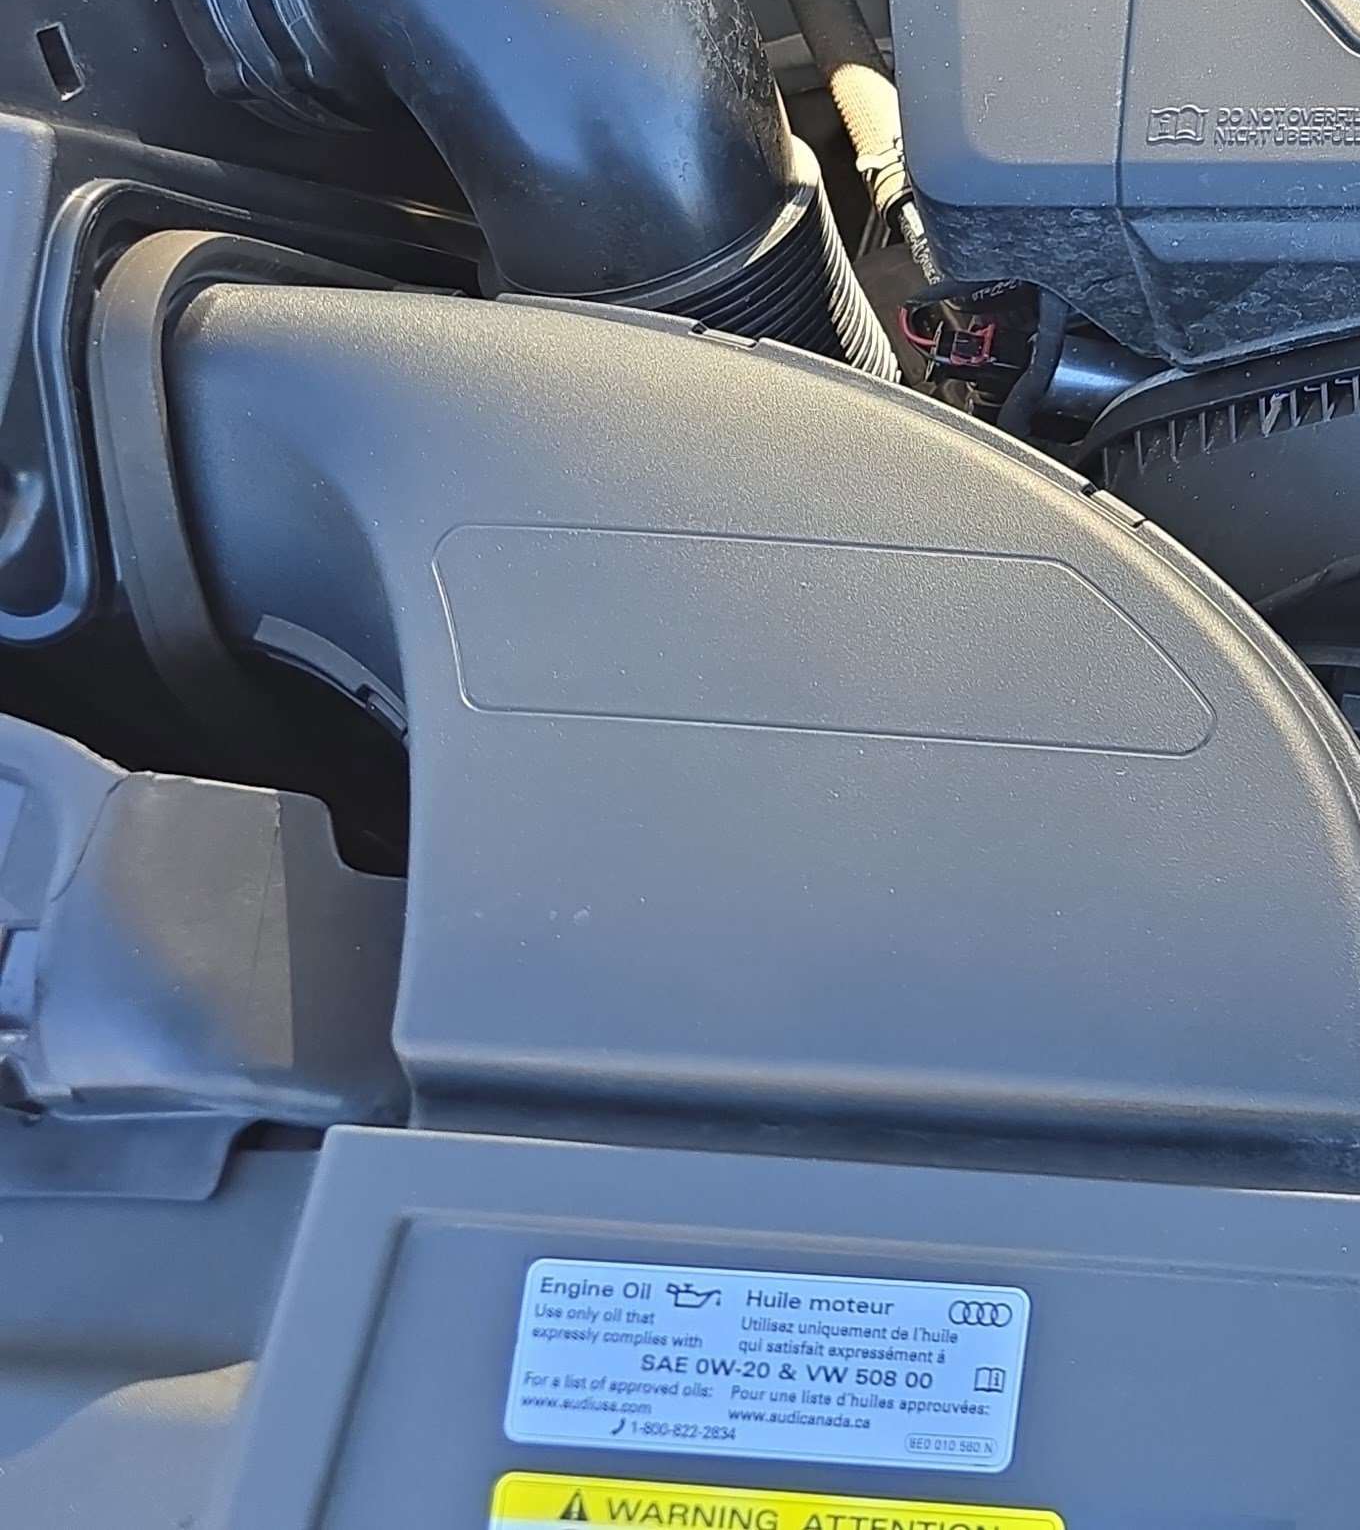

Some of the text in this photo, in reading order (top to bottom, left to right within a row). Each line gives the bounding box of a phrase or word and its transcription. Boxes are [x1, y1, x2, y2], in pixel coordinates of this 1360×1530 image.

[1216, 106, 1245, 126] DO
[1248, 106, 1287, 127] NOT
[1213, 125, 1272, 147] NICHT
[540, 1276, 652, 1300] Engine Oil
[534, 1302, 656, 1325] Use only oil that
[746, 1288, 895, 1316] Huile moteur
[531, 1325, 703, 1349] expressly complies with
[741, 1316, 794, 1334] Utilisez
[798, 1319, 887, 1340] uniquement
[890, 1326, 909, 1340] de
[738, 1337, 762, 1354] qui
[766, 1339, 824, 1357] satisfait
[828, 1346, 933, 1365] expressément
[641, 1354, 933, 1389] SAE 0W-20 & VW 508 00
[523, 1370, 549, 1386] For
[564, 1373, 587, 1389] list
[590, 1375, 607, 1391] of
[608, 1379, 678, 1397] approved
[682, 1382, 713, 1398] oils:
[730, 1384, 765, 1401] Pour
[769, 1389, 797, 1403] une
[801, 1390, 831, 1406] liste
[521, 1394, 652, 1414] www.audiusa.com
[631, 1420, 736, 1440] 1-800-822-2834
[728, 1407, 871, 1429] www.audicanada.ca
[607, 1497, 779, 1530] WARNING
